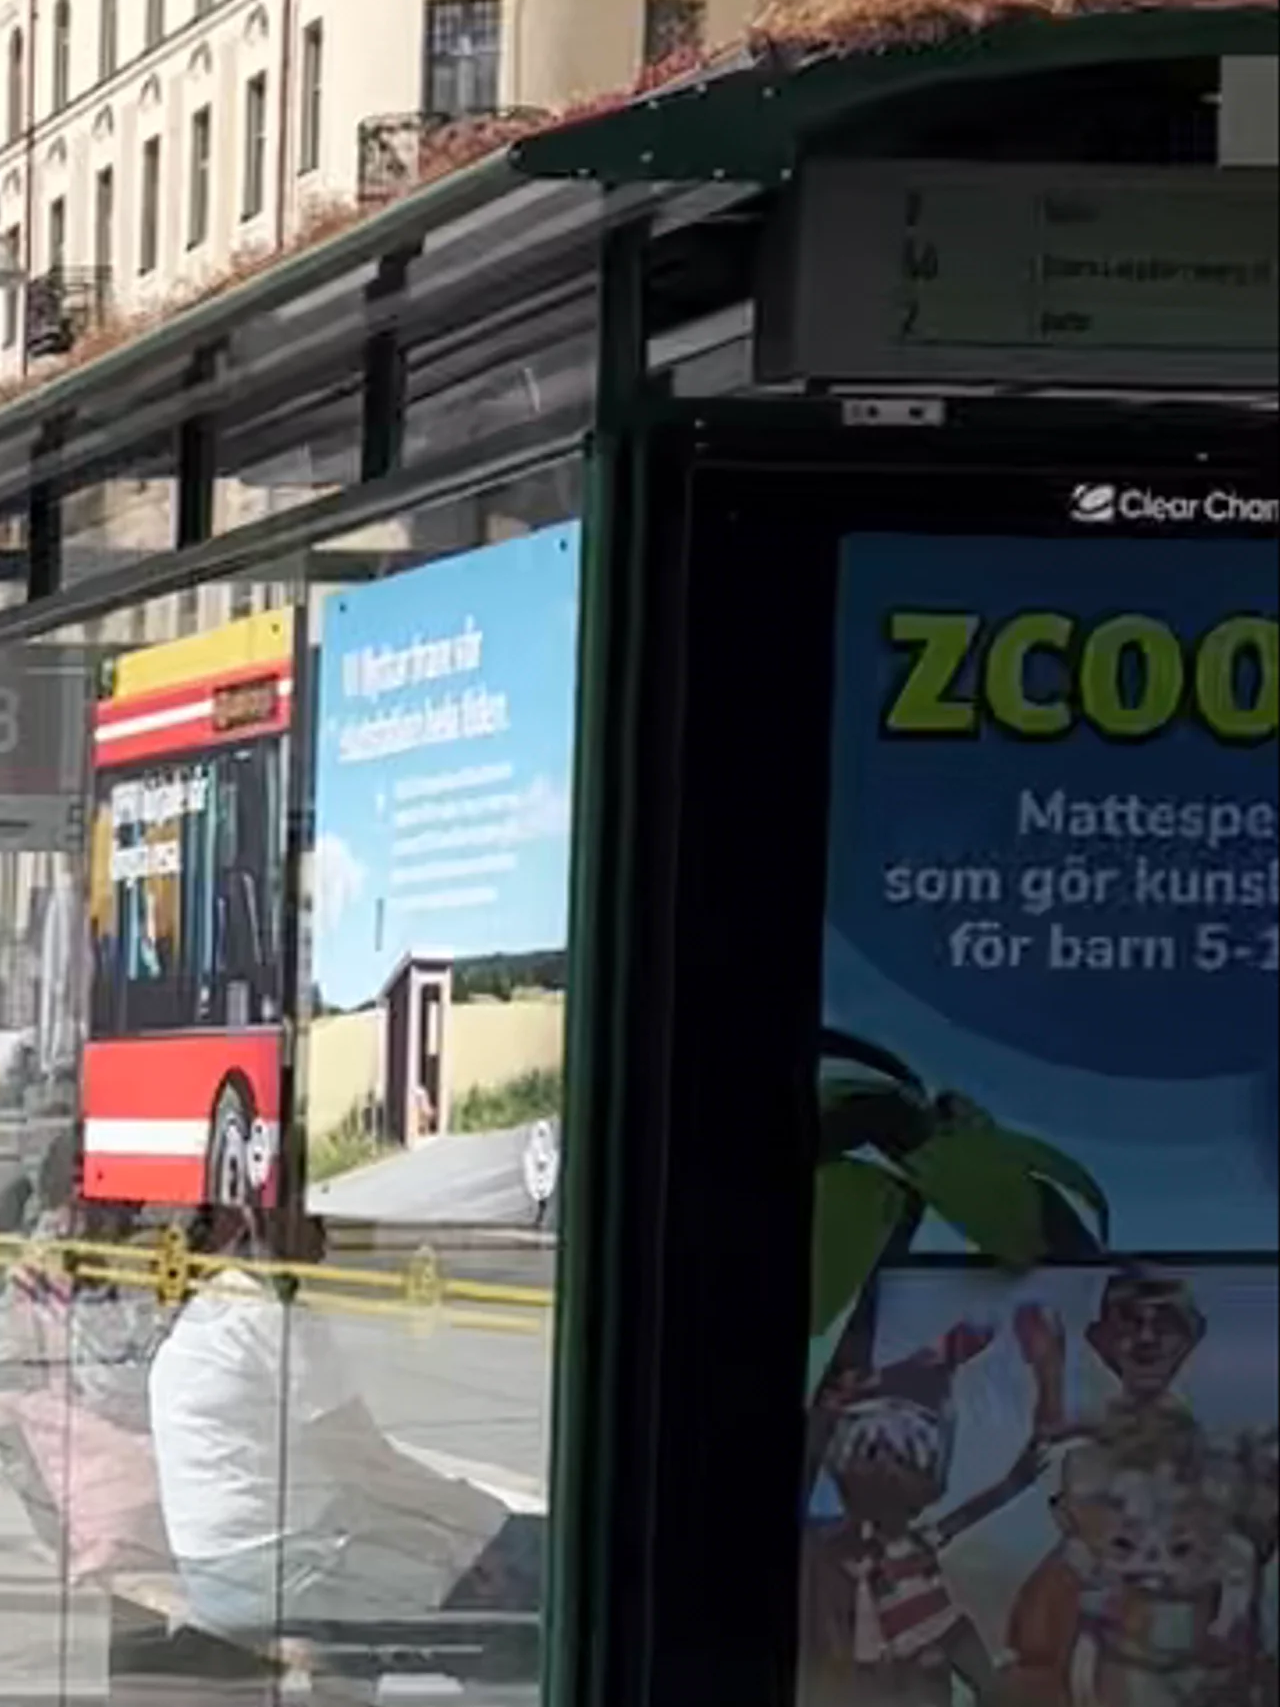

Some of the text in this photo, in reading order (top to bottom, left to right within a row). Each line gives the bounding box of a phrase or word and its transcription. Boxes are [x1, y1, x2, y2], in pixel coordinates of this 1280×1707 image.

[1119, 486, 1200, 521] Clear
[886, 611, 1278, 737] ZCOO
[1019, 789, 1275, 849] Mattespe
[884, 865, 1003, 903] som
[1020, 855, 1120, 917] gör
[949, 919, 1035, 969] för
[1050, 921, 1176, 970] barn
